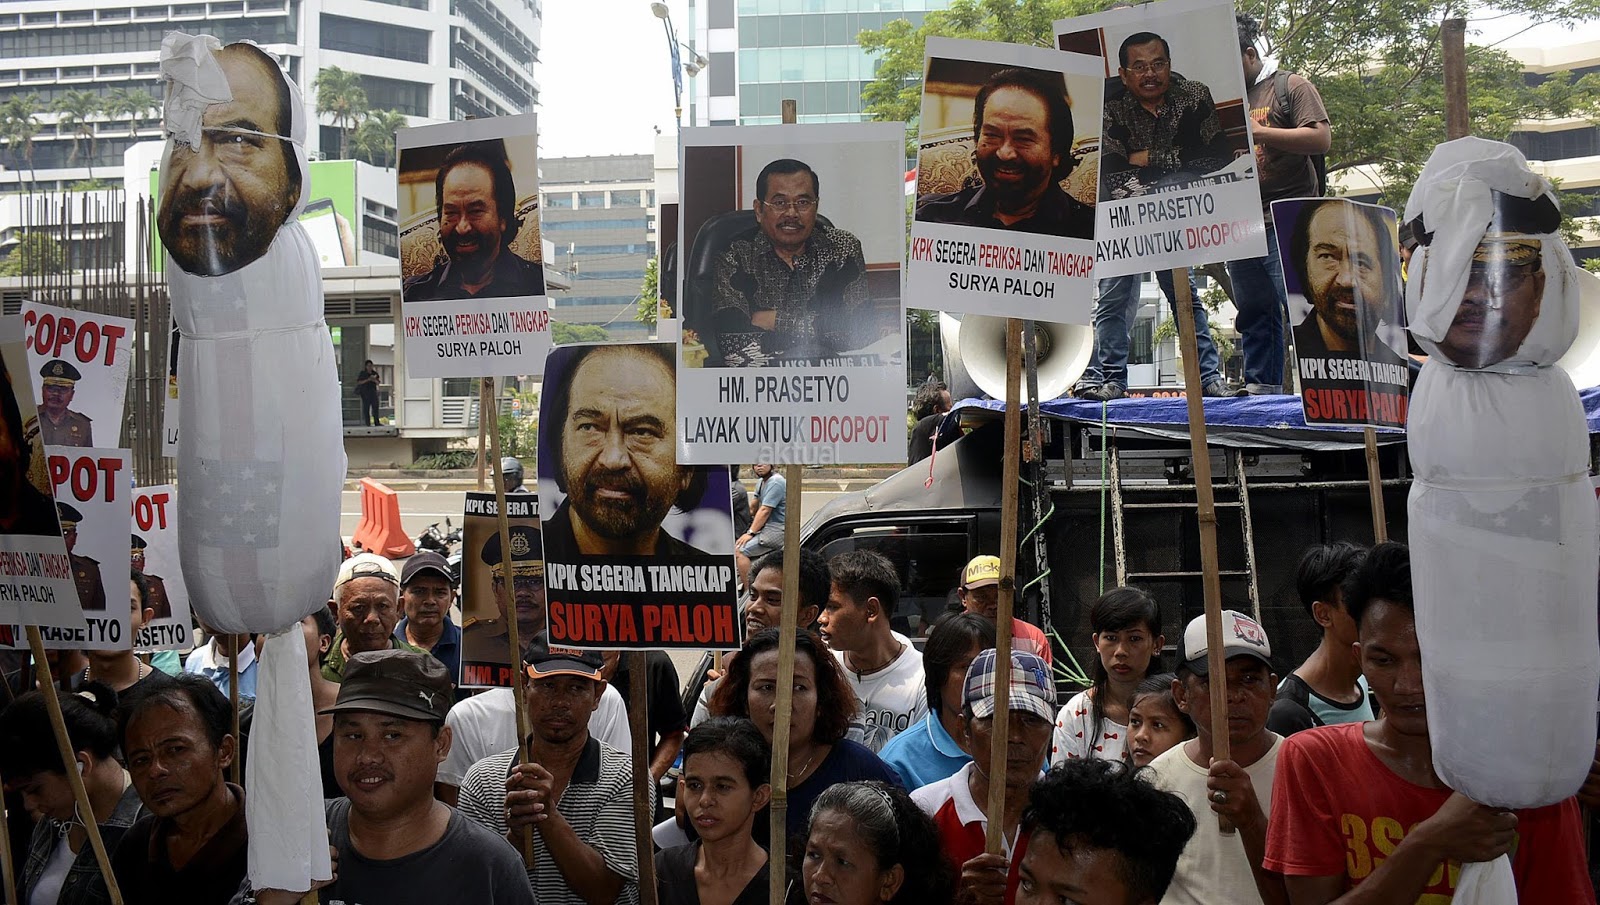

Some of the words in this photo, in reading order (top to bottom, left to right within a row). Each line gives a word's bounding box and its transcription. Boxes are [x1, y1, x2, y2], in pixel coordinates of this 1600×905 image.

[1109, 205, 1135, 228] HM.
[1138, 192, 1215, 224] PRASETYO
[912, 237, 934, 262] KPK
[935, 239, 976, 266] SEGERA
[978, 243, 1022, 271] PERIKSA
[1024, 248, 1045, 273] DAN
[1047, 251, 1093, 278] TANGKAP
[1096, 237, 1132, 262] AYAK
[1134, 229, 1184, 257] UNTUK
[949, 272, 999, 293] SURYA
[1004, 278, 1055, 298] PALOH
[405, 316, 422, 337] KPK
[423, 315, 455, 337] SEGERA
[455, 313, 491, 335] PERIKSA
[491, 312, 509, 333] DAN
[510, 310, 549, 332] TANGKAP
[437, 342, 477, 357] SURYA
[480, 340, 522, 356] PALOH
[1300, 358, 1328, 379] KPK
[1328, 358, 1371, 382] SEGERA
[718, 376, 749, 403] HM.
[755, 375, 849, 402] PRASETYO
[1304, 388, 1371, 420] SURYA
[684, 416, 740, 443] LAYAK
[745, 416, 805, 443] UNTUK
[810, 415, 890, 443] DICOPOT
[465, 499, 486, 514] KPK
[486, 501, 529, 516] SEERA
[25, 552, 42, 577] DAN
[39, 553, 70, 580] TANGKAP
[548, 563, 579, 591] KPK
[581, 565, 647, 592] SEGERA
[648, 565, 731, 593] TANGKAP
[968, 562, 1000, 577] Mick
[0, 584, 21, 602] RYA
[21, 585, 56, 604] PALOH
[39, 618, 121, 643] RASETYO
[133, 623, 186, 648] ASETYO
[550, 601, 638, 642] SURYA
[642, 604, 734, 644] PALOH
[464, 665, 497, 685] HM.
